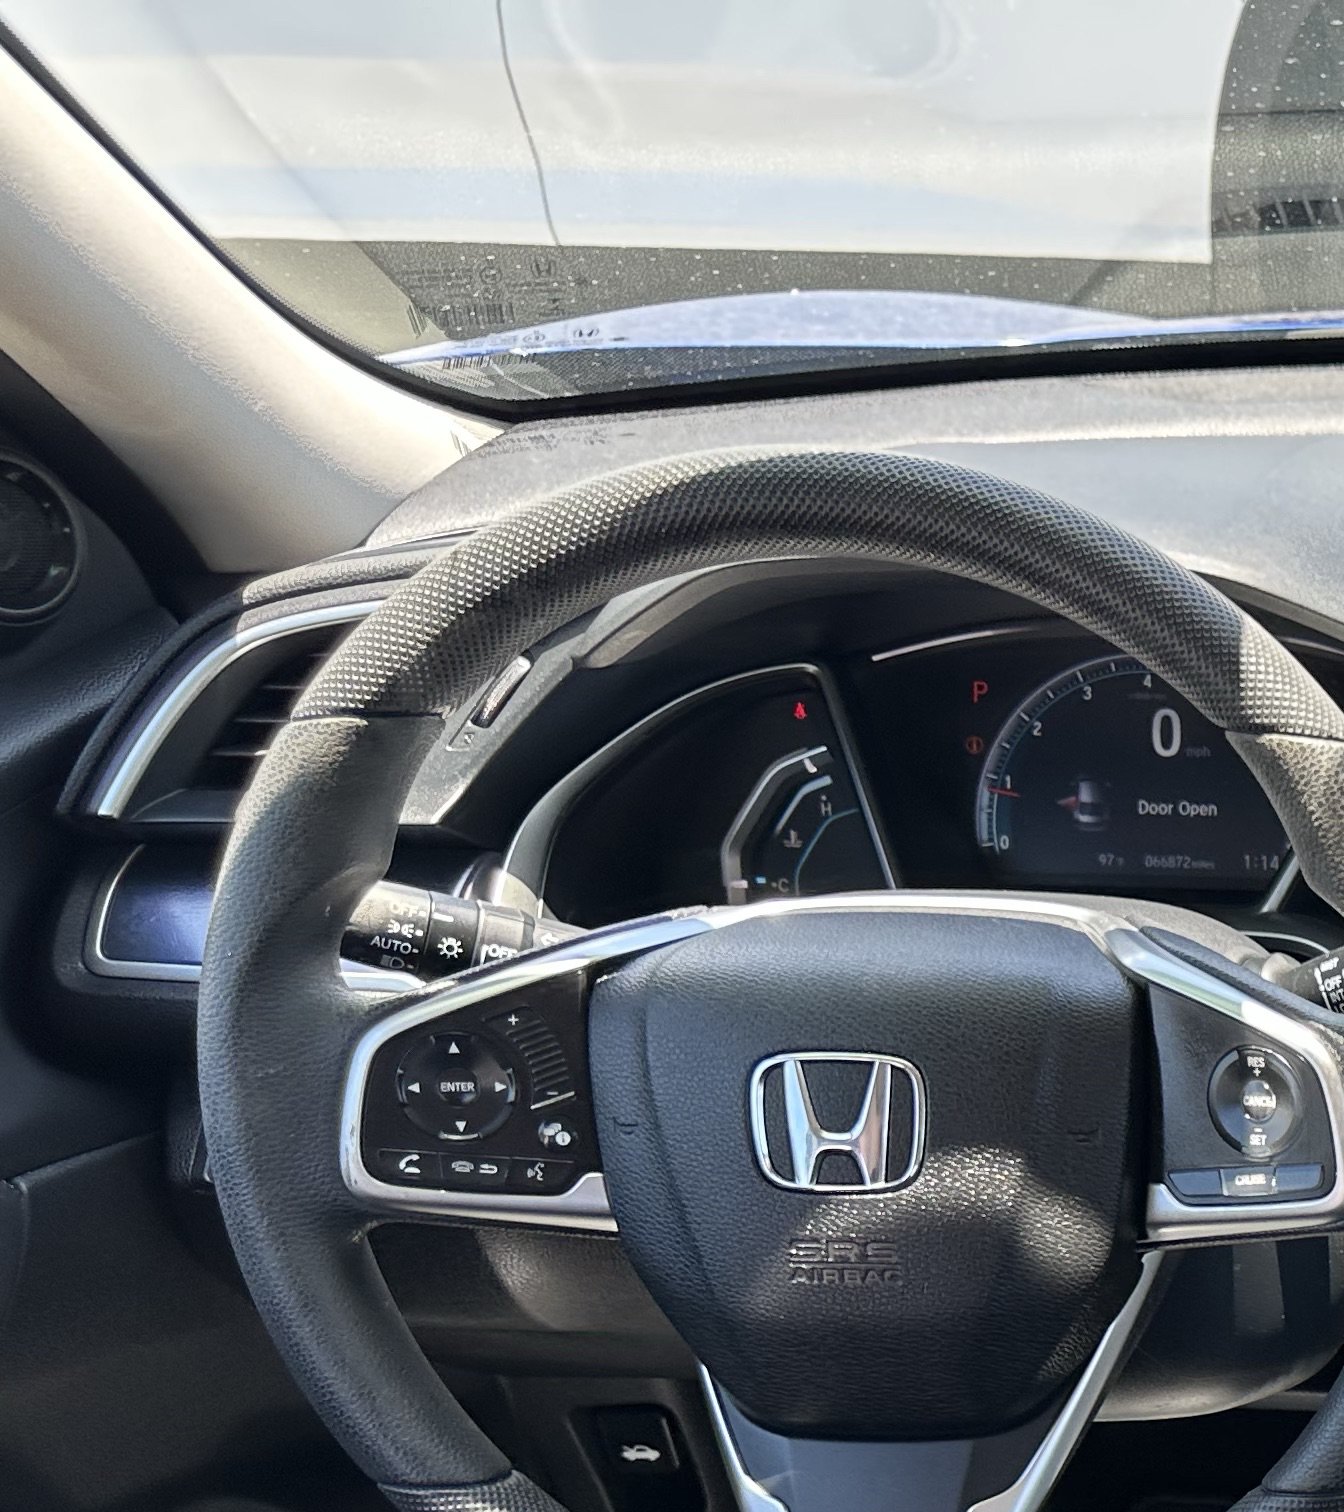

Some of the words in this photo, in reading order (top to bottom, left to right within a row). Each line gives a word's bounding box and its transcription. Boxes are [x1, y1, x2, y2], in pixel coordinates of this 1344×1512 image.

[972, 681, 988, 702] P
[1083, 686, 1092, 700] 3
[1033, 722, 1042, 736] 2
[1152, 708, 1181, 757] 0
[1138, 799, 1173, 815] Door
[1178, 801, 1218, 818] Open
[1244, 855, 1280, 870] 1:14
[371, 935, 412, 955] AUTO
[1324, 975, 1342, 991] OFF
[440, 1081, 475, 1093] ENTER
[1250, 1134, 1267, 1146] SET
